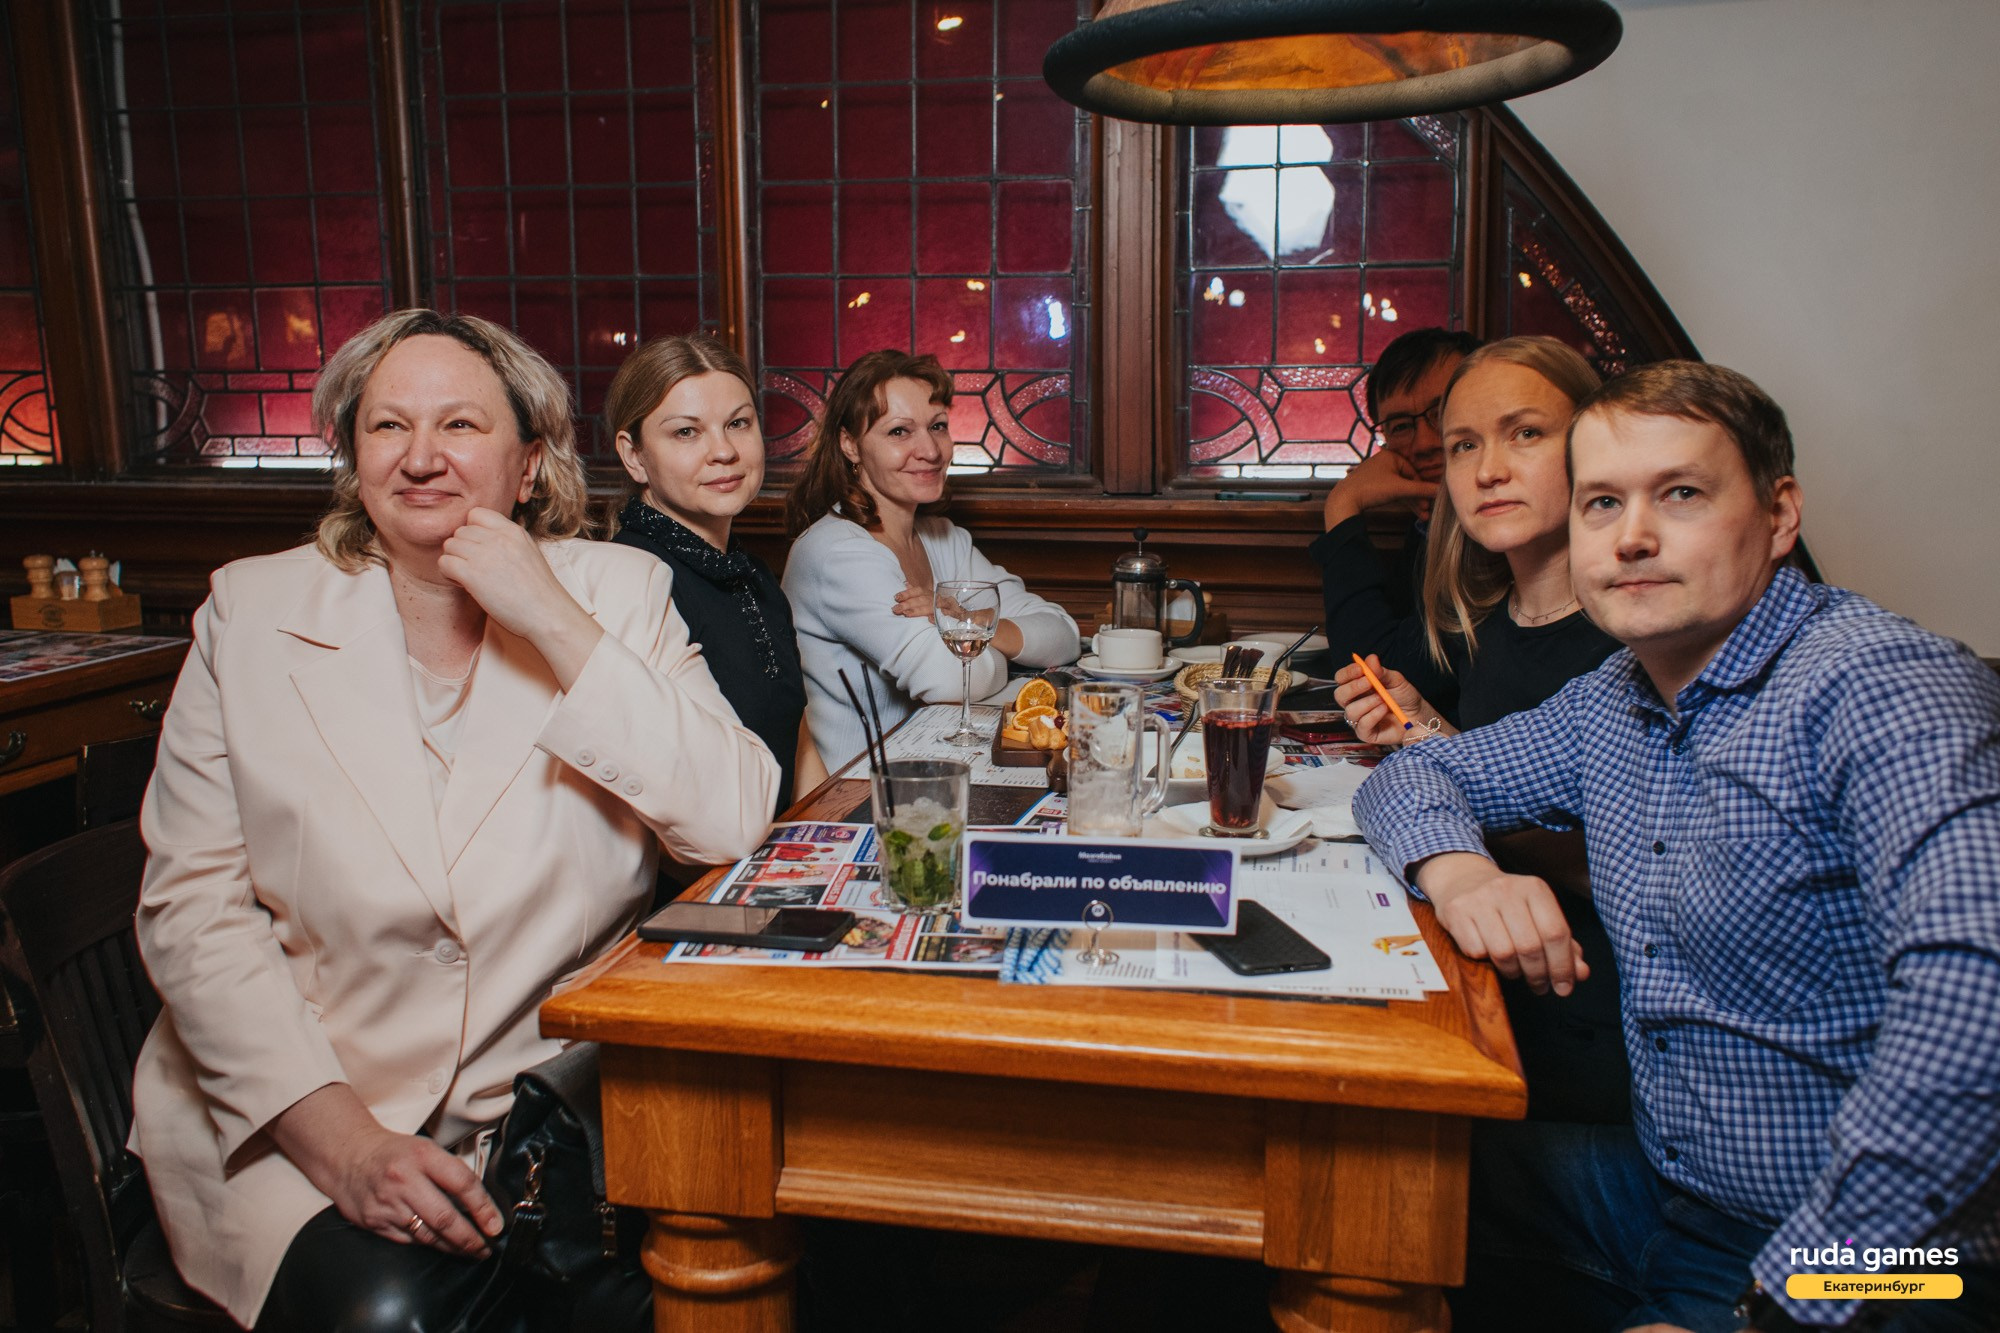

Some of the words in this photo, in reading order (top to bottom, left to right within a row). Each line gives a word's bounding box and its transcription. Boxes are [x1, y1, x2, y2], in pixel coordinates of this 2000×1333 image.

[973, 871, 1077, 890] Понабрали
[1081, 877, 1105, 889] по
[1108, 875, 1226, 894] объявлению
